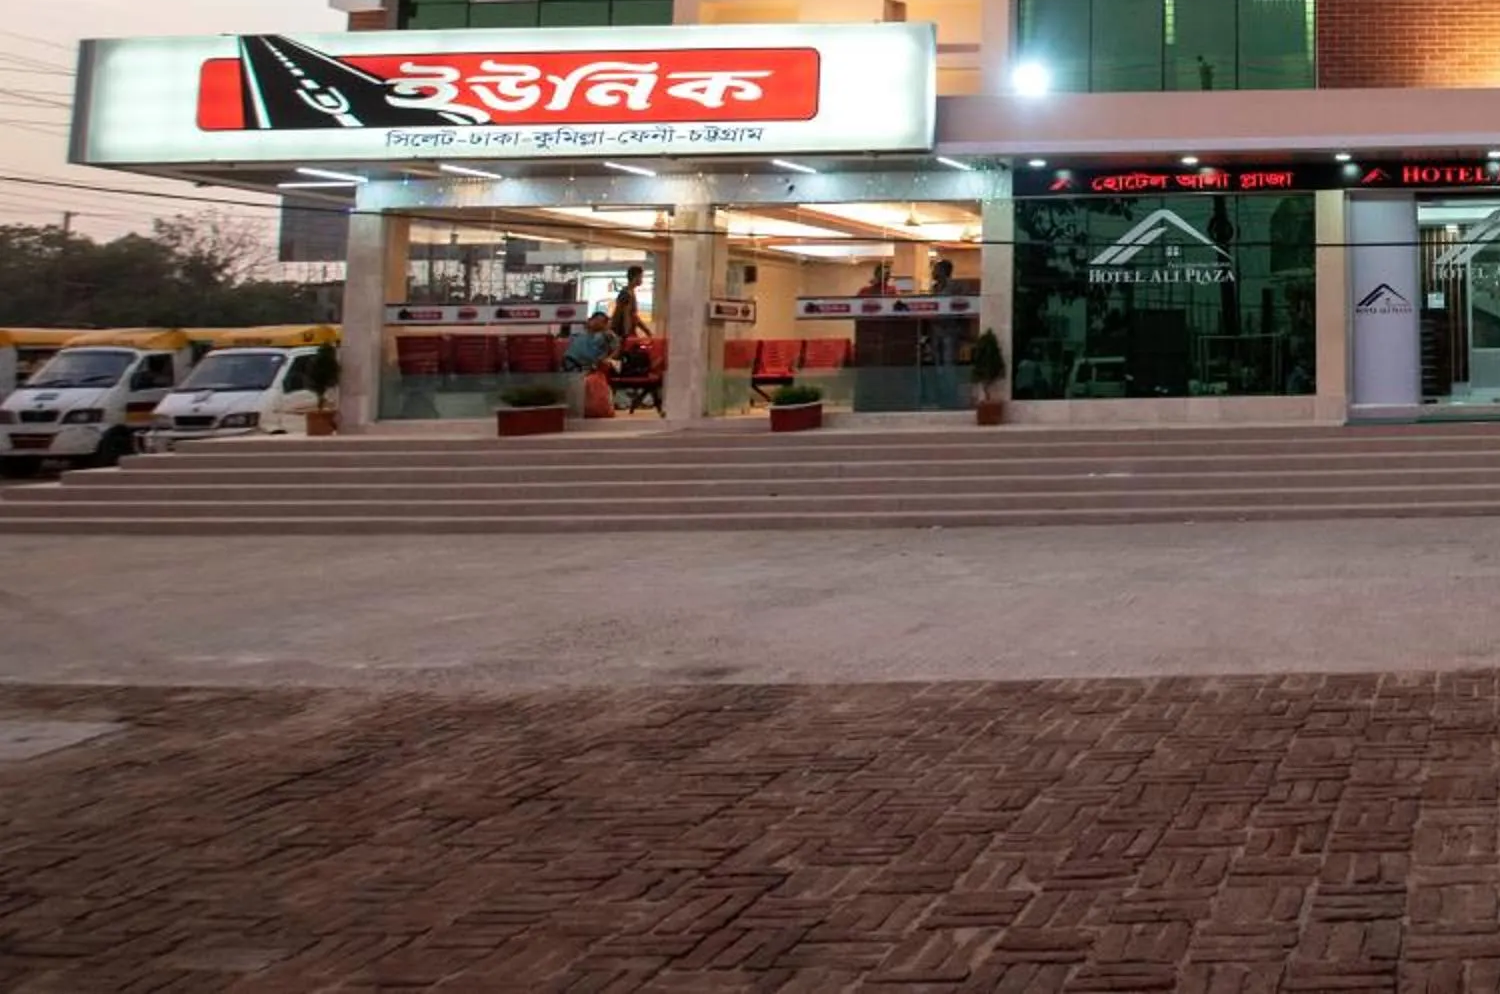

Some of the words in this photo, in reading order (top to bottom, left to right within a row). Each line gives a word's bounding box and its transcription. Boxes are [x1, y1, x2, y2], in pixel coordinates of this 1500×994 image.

[385, 59, 775, 123] ইউনিক
[1091, 173, 1169, 191] হোটেল
[1403, 165, 1491, 183] HOTEL
[1088, 268, 1146, 283] HOTEL
[1150, 268, 1180, 283] ALI
[1185, 268, 1235, 285] PLAZA
